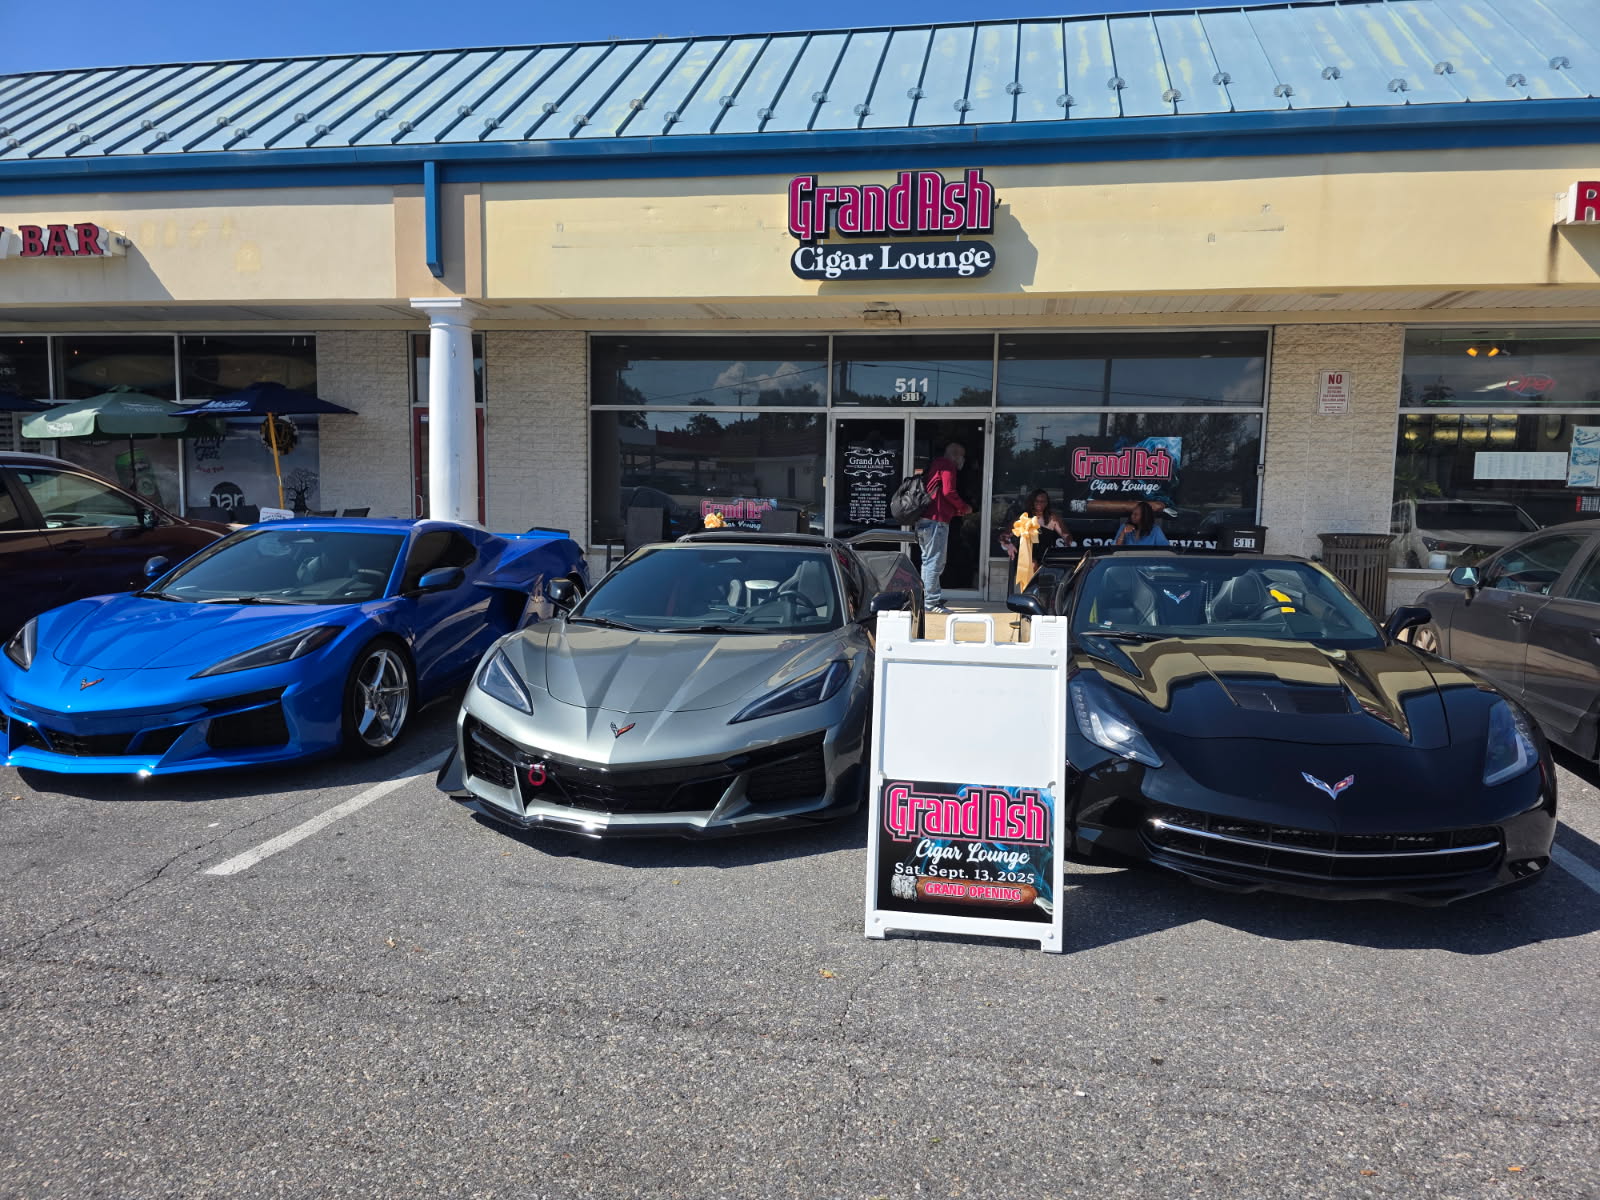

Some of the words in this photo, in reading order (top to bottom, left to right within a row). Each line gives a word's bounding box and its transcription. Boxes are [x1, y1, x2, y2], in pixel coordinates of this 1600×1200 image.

[789, 171, 912, 240] Grand
[917, 169, 992, 230] Ash
[19, 222, 104, 256] BAR
[794, 246, 874, 278] Cigar
[879, 245, 992, 276] Lounge
[894, 377, 929, 393] 511
[1328, 374, 1343, 385] NO
[902, 392, 919, 401] 511
[849, 456, 873, 465] Grand
[874, 457, 890, 465] Ash
[1073, 448, 1130, 479] Grand
[1134, 449, 1171, 478] Ash
[1090, 479, 1119, 495] Cigar
[1121, 480, 1161, 495] Lounge
[1234, 538, 1255, 549] 511
[888, 786, 981, 837] Grand
[987, 792, 1045, 841] Ash
[915, 838, 963, 865] Cigar
[966, 843, 1030, 870] Lounge
[894, 862, 925, 876] Sat.
[928, 865, 969, 879] Sept.
[974, 869, 994, 882] 13,
[997, 871, 1035, 884] 2025
[925, 882, 966, 897] GRAND
[969, 884, 1021, 900] OPENING
